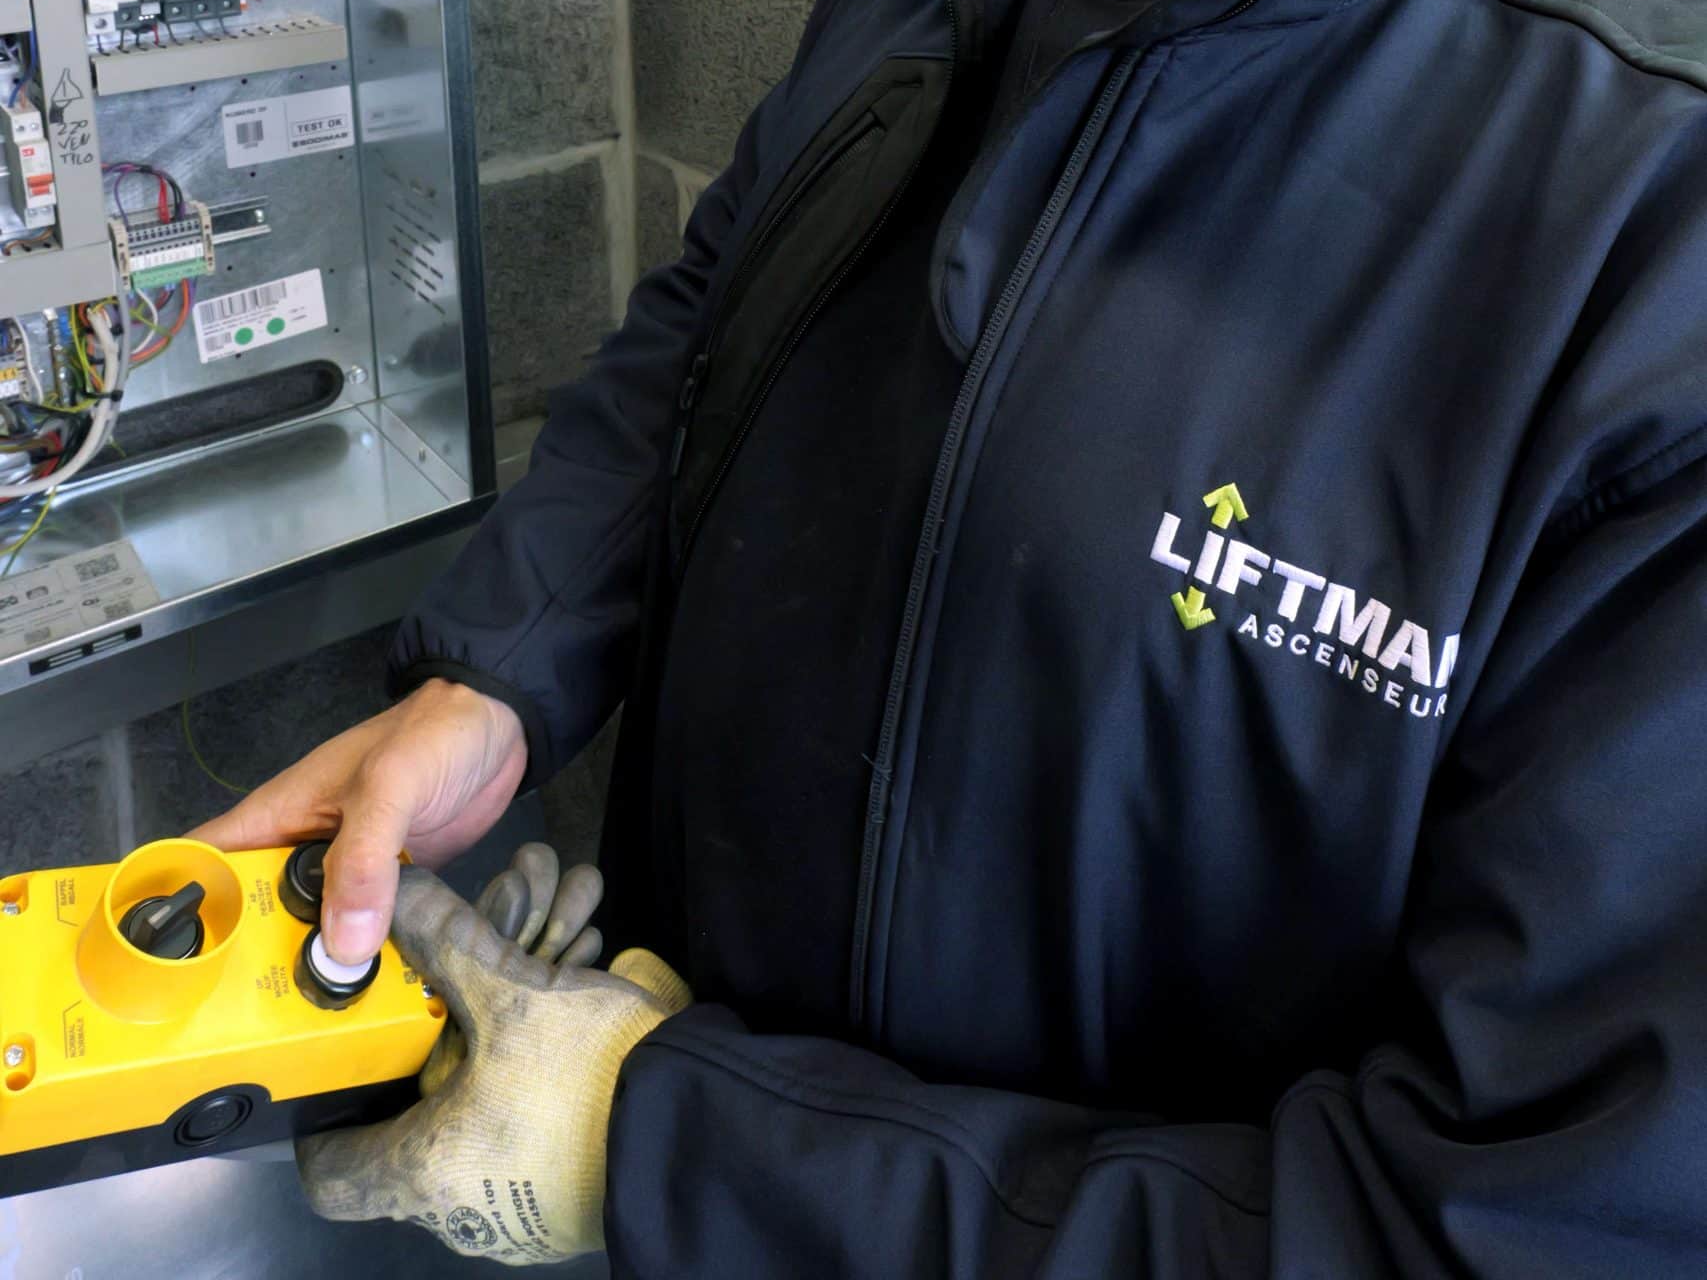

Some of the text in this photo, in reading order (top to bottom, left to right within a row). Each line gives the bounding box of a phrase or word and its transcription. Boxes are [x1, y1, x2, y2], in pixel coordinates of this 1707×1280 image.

[297, 118, 343, 133] TEST OK
[483, 1178, 496, 1206] 100
